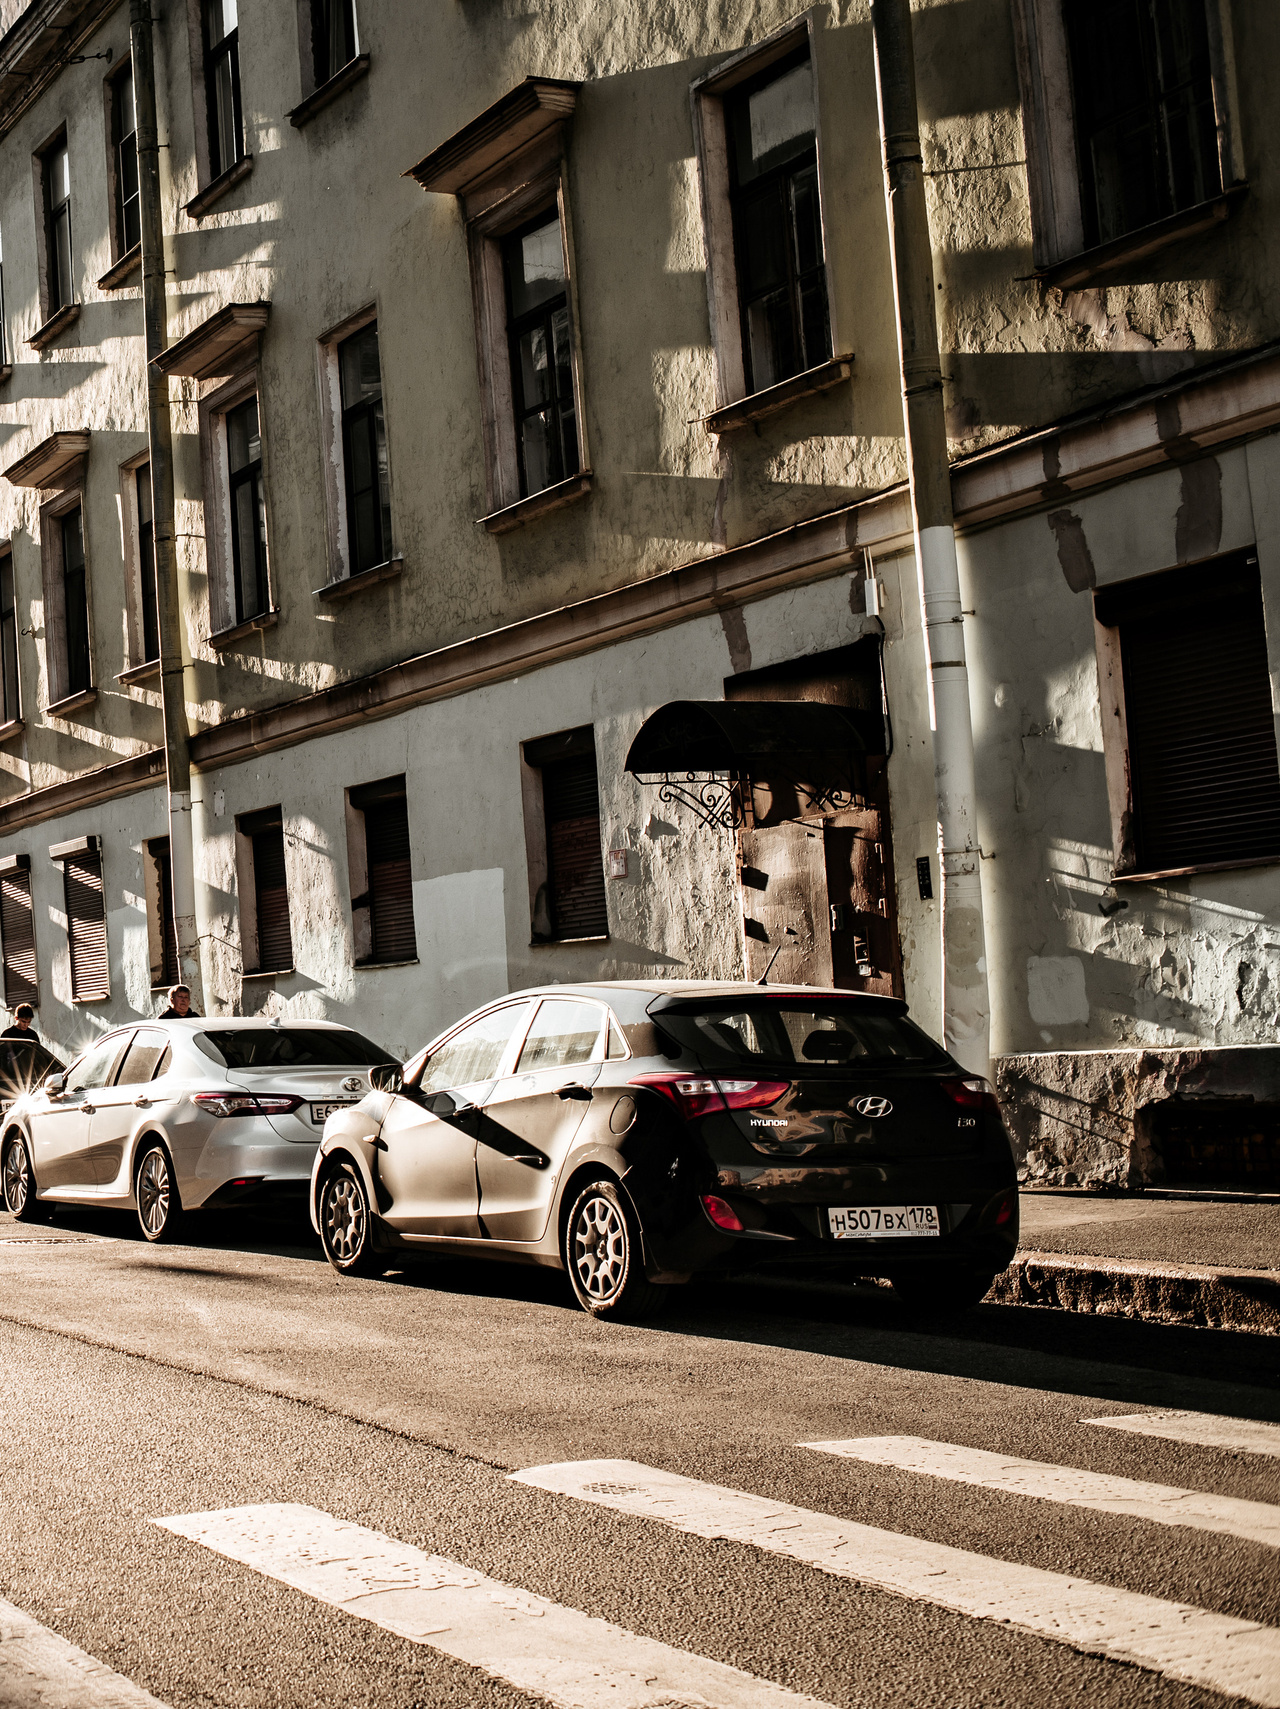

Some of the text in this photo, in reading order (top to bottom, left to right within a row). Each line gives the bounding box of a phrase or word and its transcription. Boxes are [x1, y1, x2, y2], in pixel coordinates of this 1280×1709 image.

[750, 1119, 789, 1127] HYUNDAI
[957, 1117, 976, 1127] i30
[908, 1207, 934, 1224] 178
